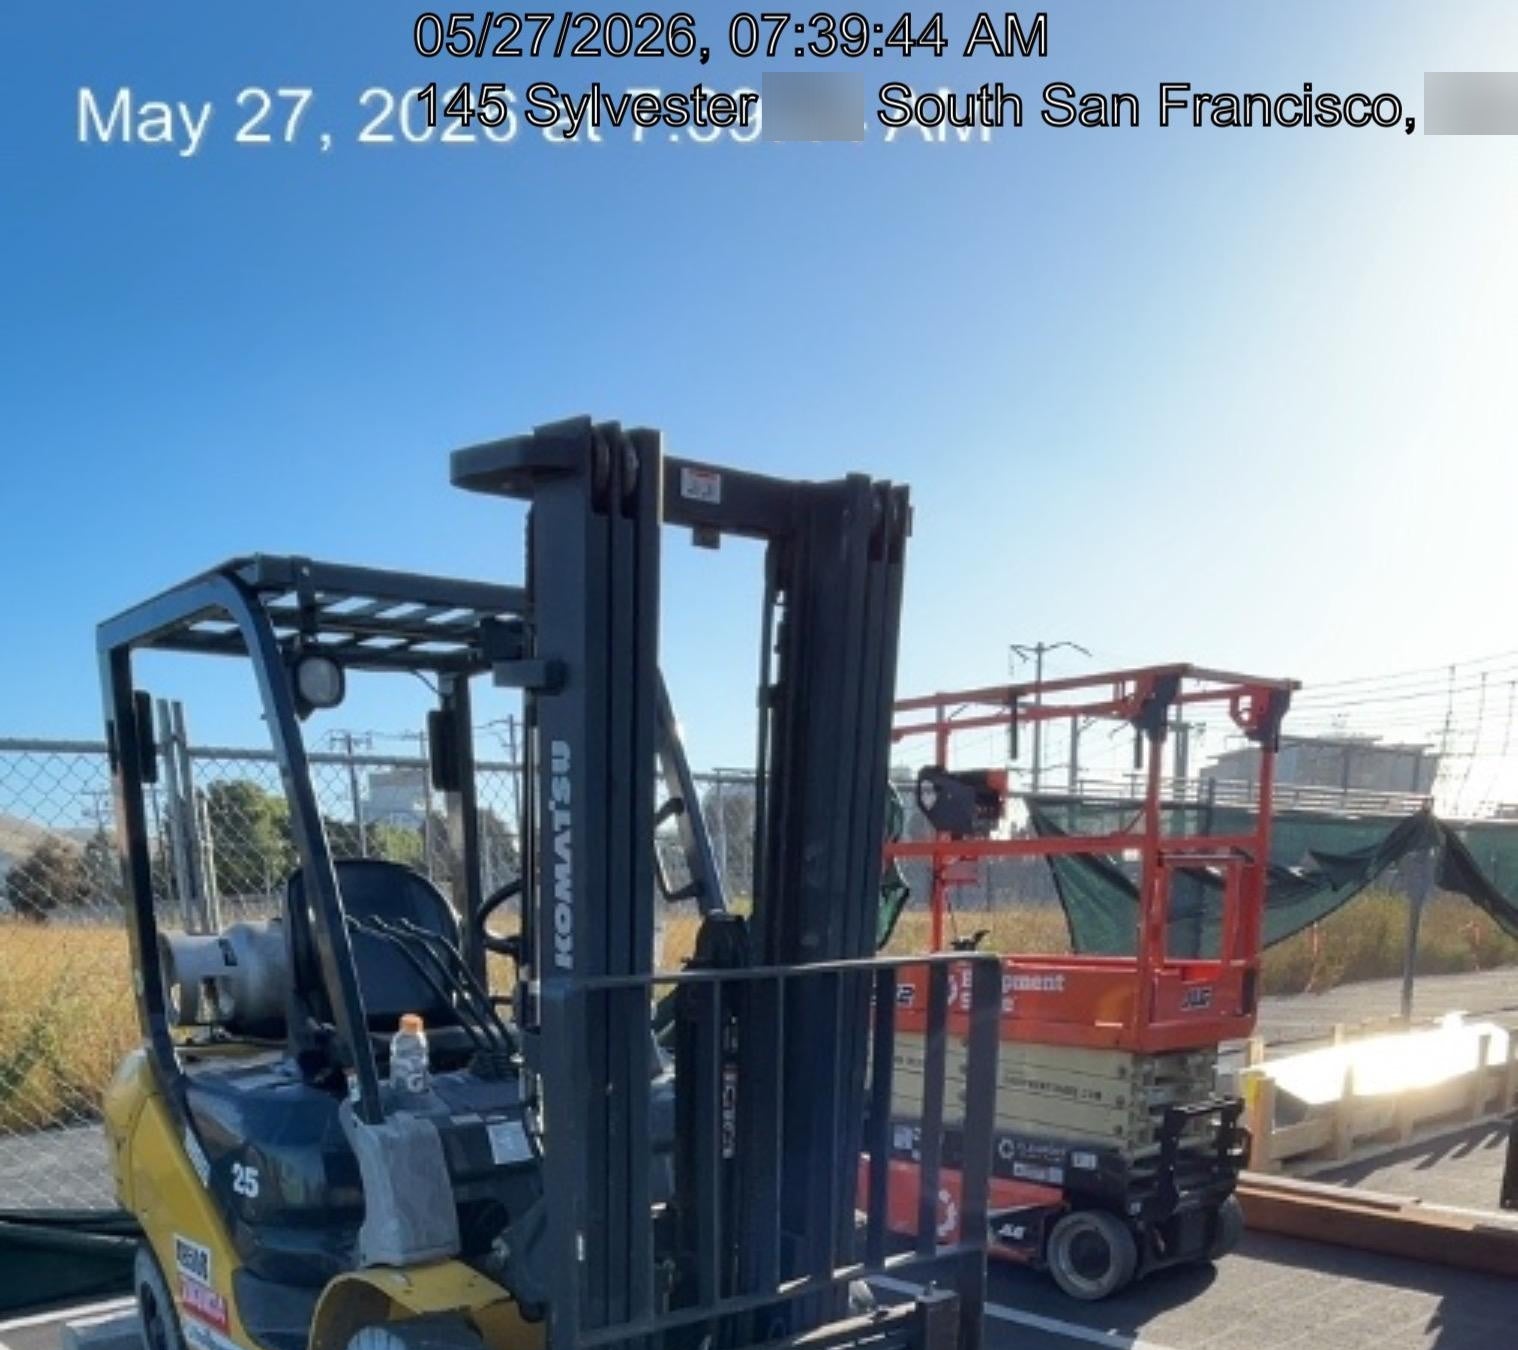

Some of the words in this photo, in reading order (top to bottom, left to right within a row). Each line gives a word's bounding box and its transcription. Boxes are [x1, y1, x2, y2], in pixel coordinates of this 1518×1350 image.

[548, 739, 574, 970] KOMATSU
[960, 968, 1066, 997] Epment
[231, 1161, 260, 1199] 25
